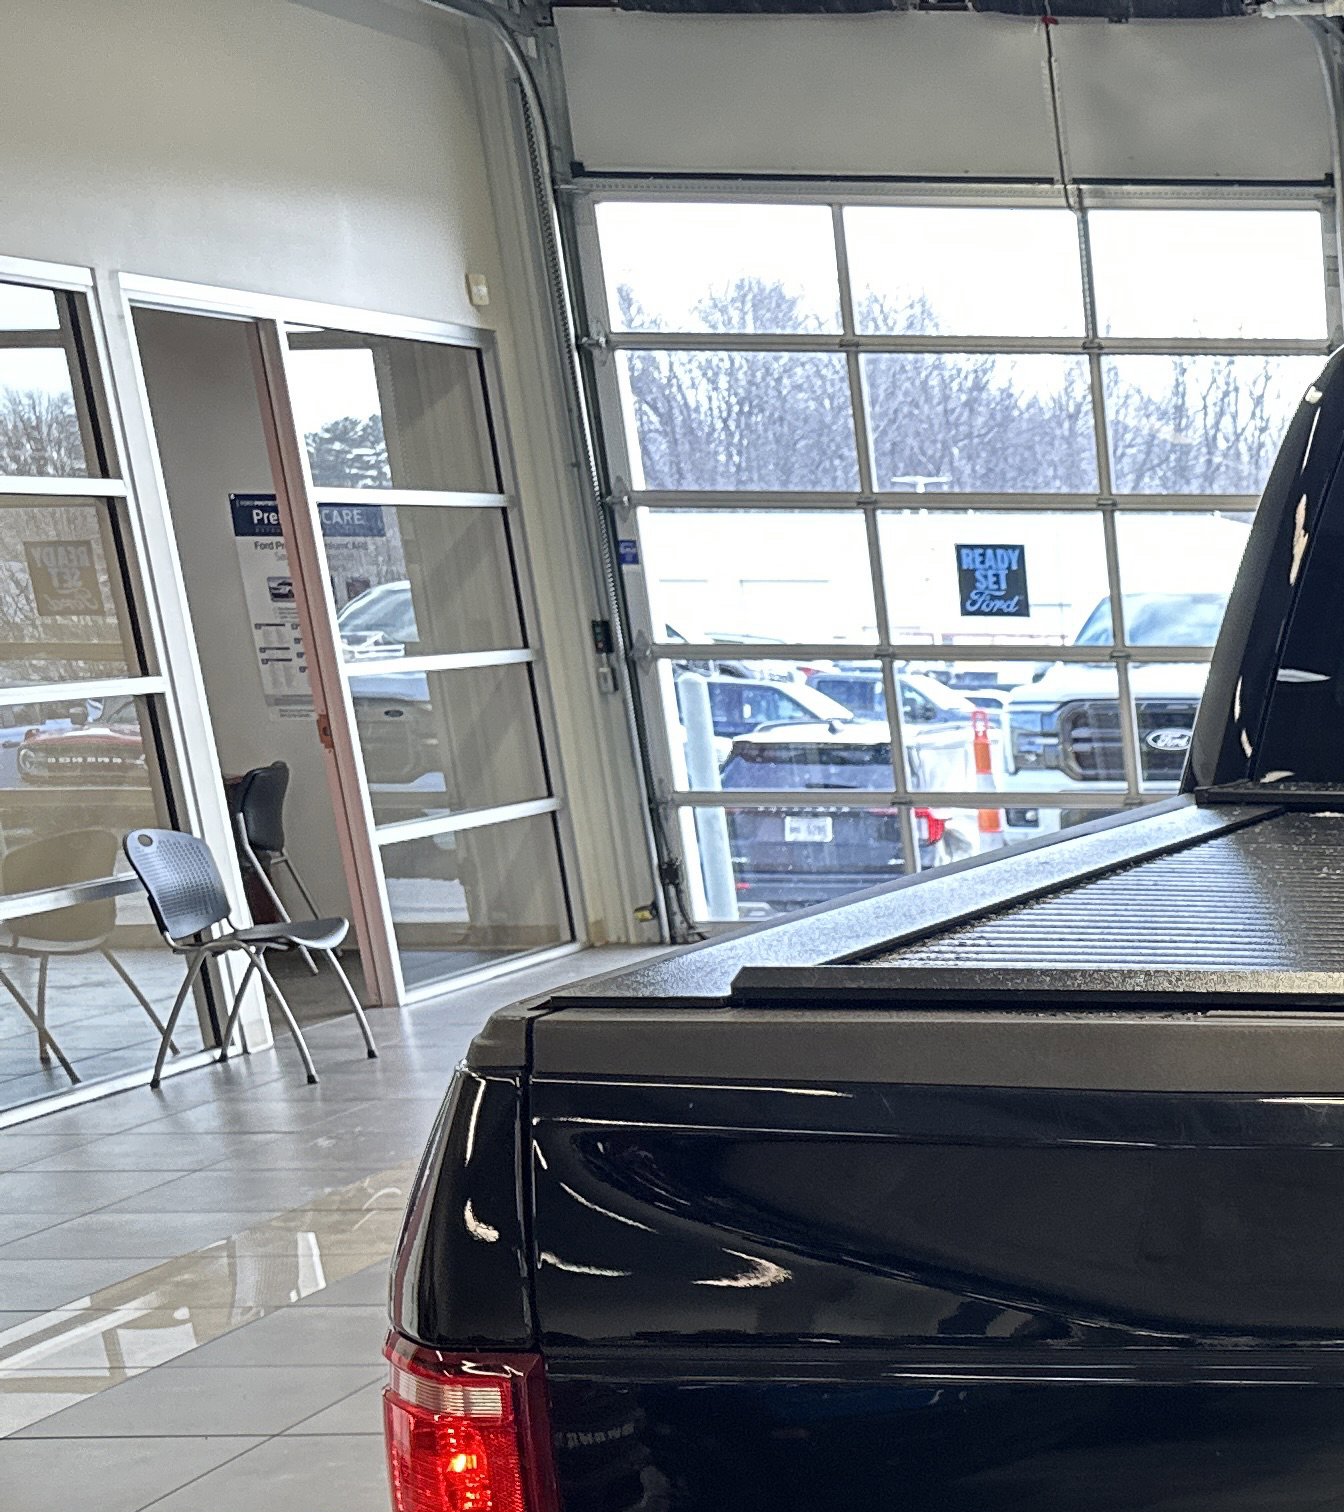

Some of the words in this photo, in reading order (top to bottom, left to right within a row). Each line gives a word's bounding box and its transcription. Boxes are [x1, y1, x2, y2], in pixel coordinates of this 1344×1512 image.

[961, 548, 1020, 570] READY
[974, 569, 1008, 590] SET
[965, 589, 1019, 612] Ford
